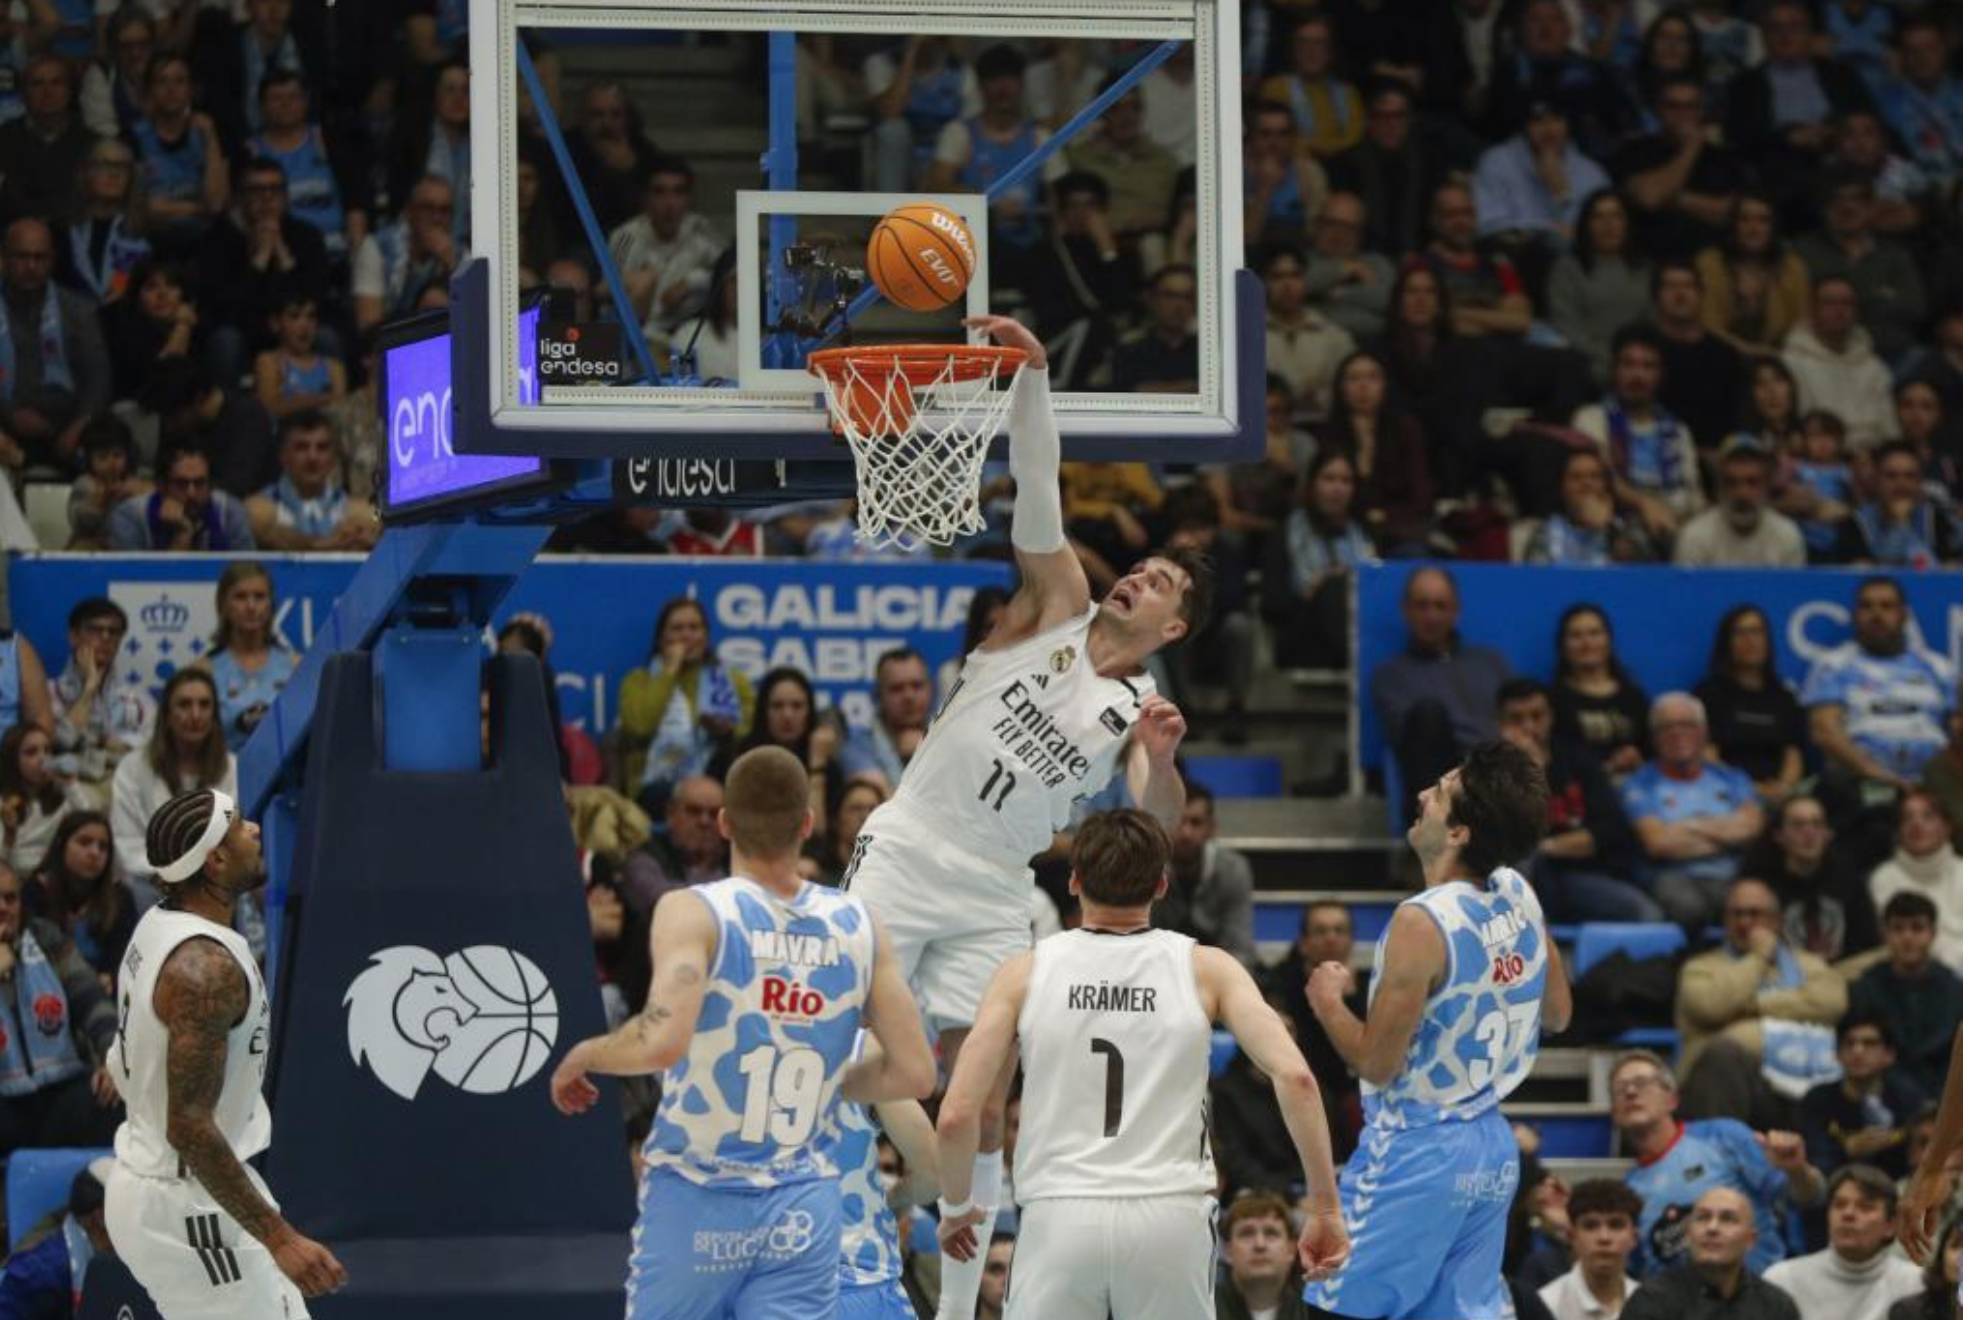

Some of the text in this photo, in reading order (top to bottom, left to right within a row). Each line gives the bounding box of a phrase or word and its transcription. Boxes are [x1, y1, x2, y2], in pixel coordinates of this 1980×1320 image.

[540, 338, 576, 358] liga
[540, 358, 619, 376] endesa
[992, 717, 1066, 788] FLY BETTER
[978, 758, 1016, 812] 11
[752, 930, 839, 966] MAVRA
[1068, 980, 1156, 1012] KRÄMER
[739, 1045, 825, 1146] 19
[1090, 1037, 1124, 1138] 1
